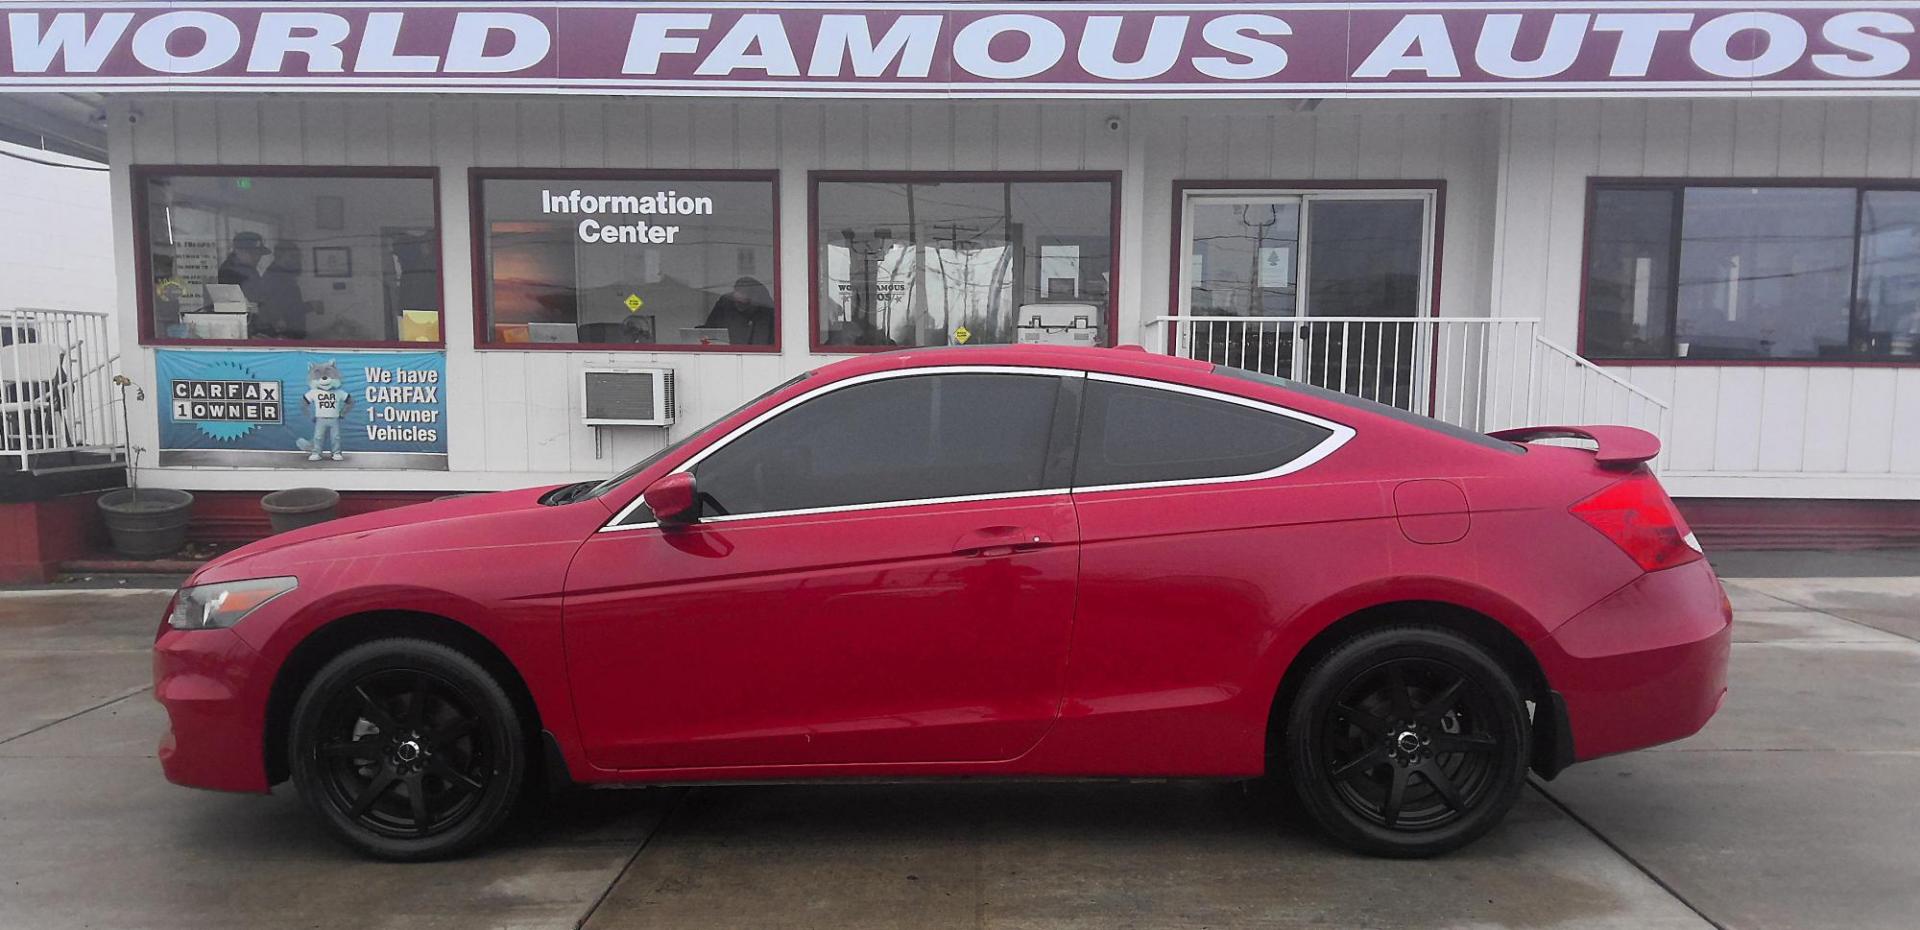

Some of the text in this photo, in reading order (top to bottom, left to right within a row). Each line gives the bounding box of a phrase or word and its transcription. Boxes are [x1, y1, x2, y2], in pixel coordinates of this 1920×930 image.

[8, 10, 1916, 80] WORLD FAMOUS AUTOS
[541, 189, 713, 215] Information
[578, 218, 680, 244] Center
[364, 367, 438, 384] We have
[175, 383, 275, 401] CARFAX
[317, 392, 336, 401] CAR
[364, 386, 438, 404] CARFAX
[318, 400, 336, 409] FOX
[366, 406, 439, 423] 1-Owner
[366, 425, 438, 442] Vehicles
